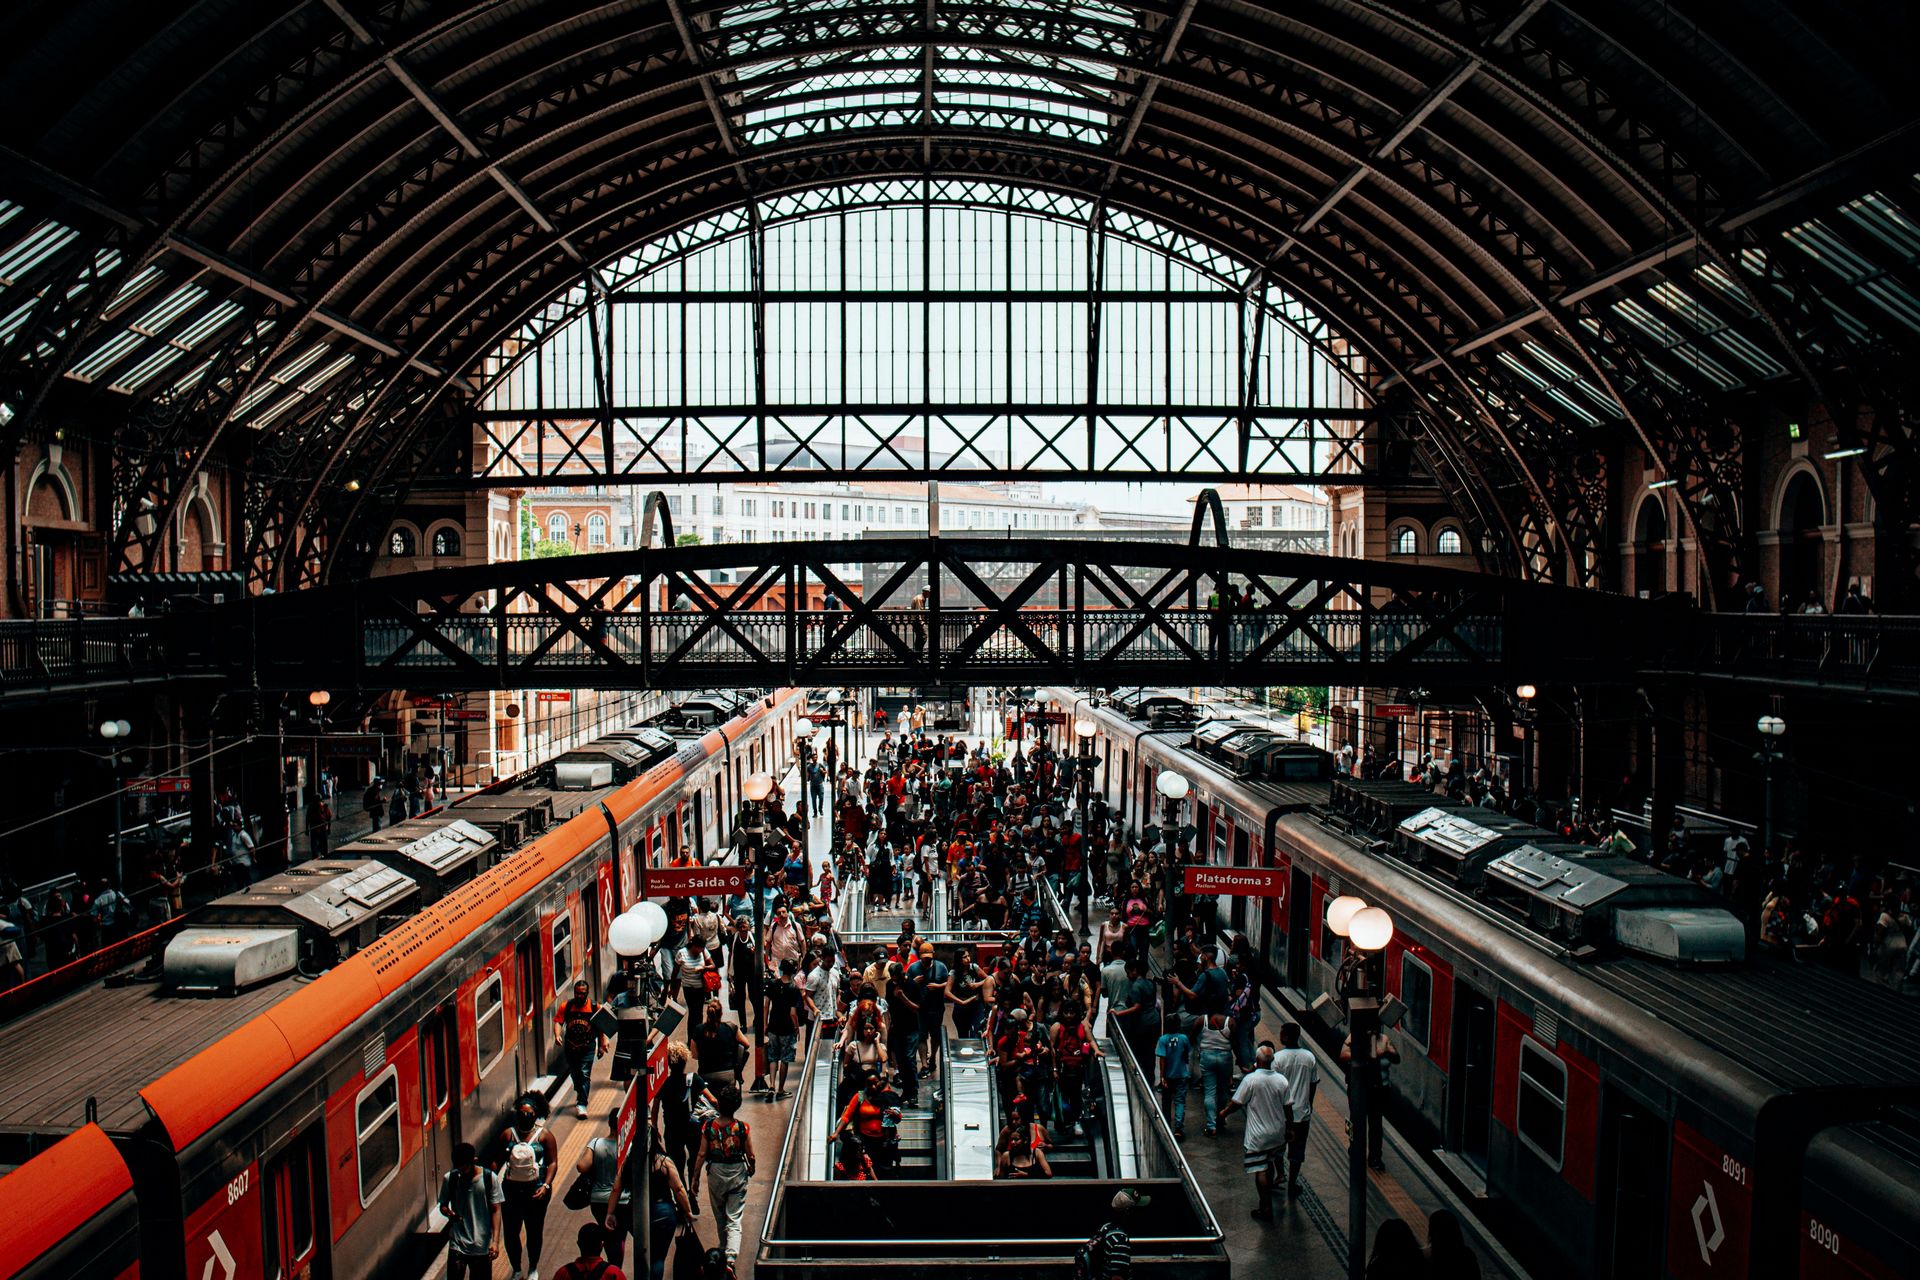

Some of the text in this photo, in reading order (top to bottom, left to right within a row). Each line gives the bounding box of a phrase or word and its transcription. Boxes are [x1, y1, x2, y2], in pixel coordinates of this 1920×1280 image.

[688, 876, 726, 888] Saída
[1196, 873, 1272, 886] Plataforma 3
[1722, 1153, 1746, 1186] 8091
[227, 1168, 249, 1206] 8607
[1809, 1218, 1840, 1256] 8090
